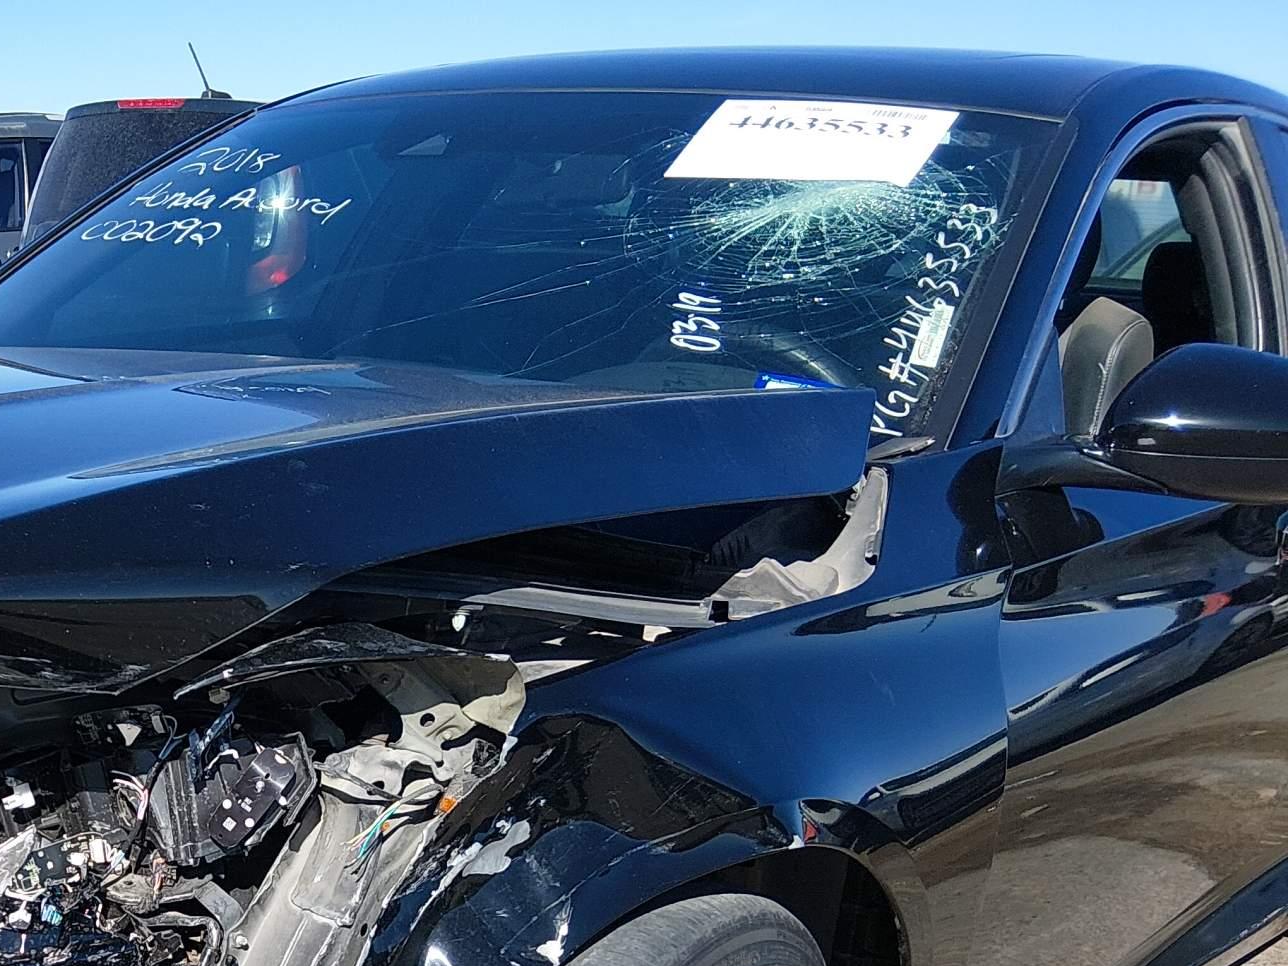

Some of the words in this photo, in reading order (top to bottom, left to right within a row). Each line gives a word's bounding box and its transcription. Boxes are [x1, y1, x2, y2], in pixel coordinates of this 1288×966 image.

[728, 115, 913, 139] 44635533
[177, 147, 281, 175] 2018
[129, 181, 216, 210] Honda
